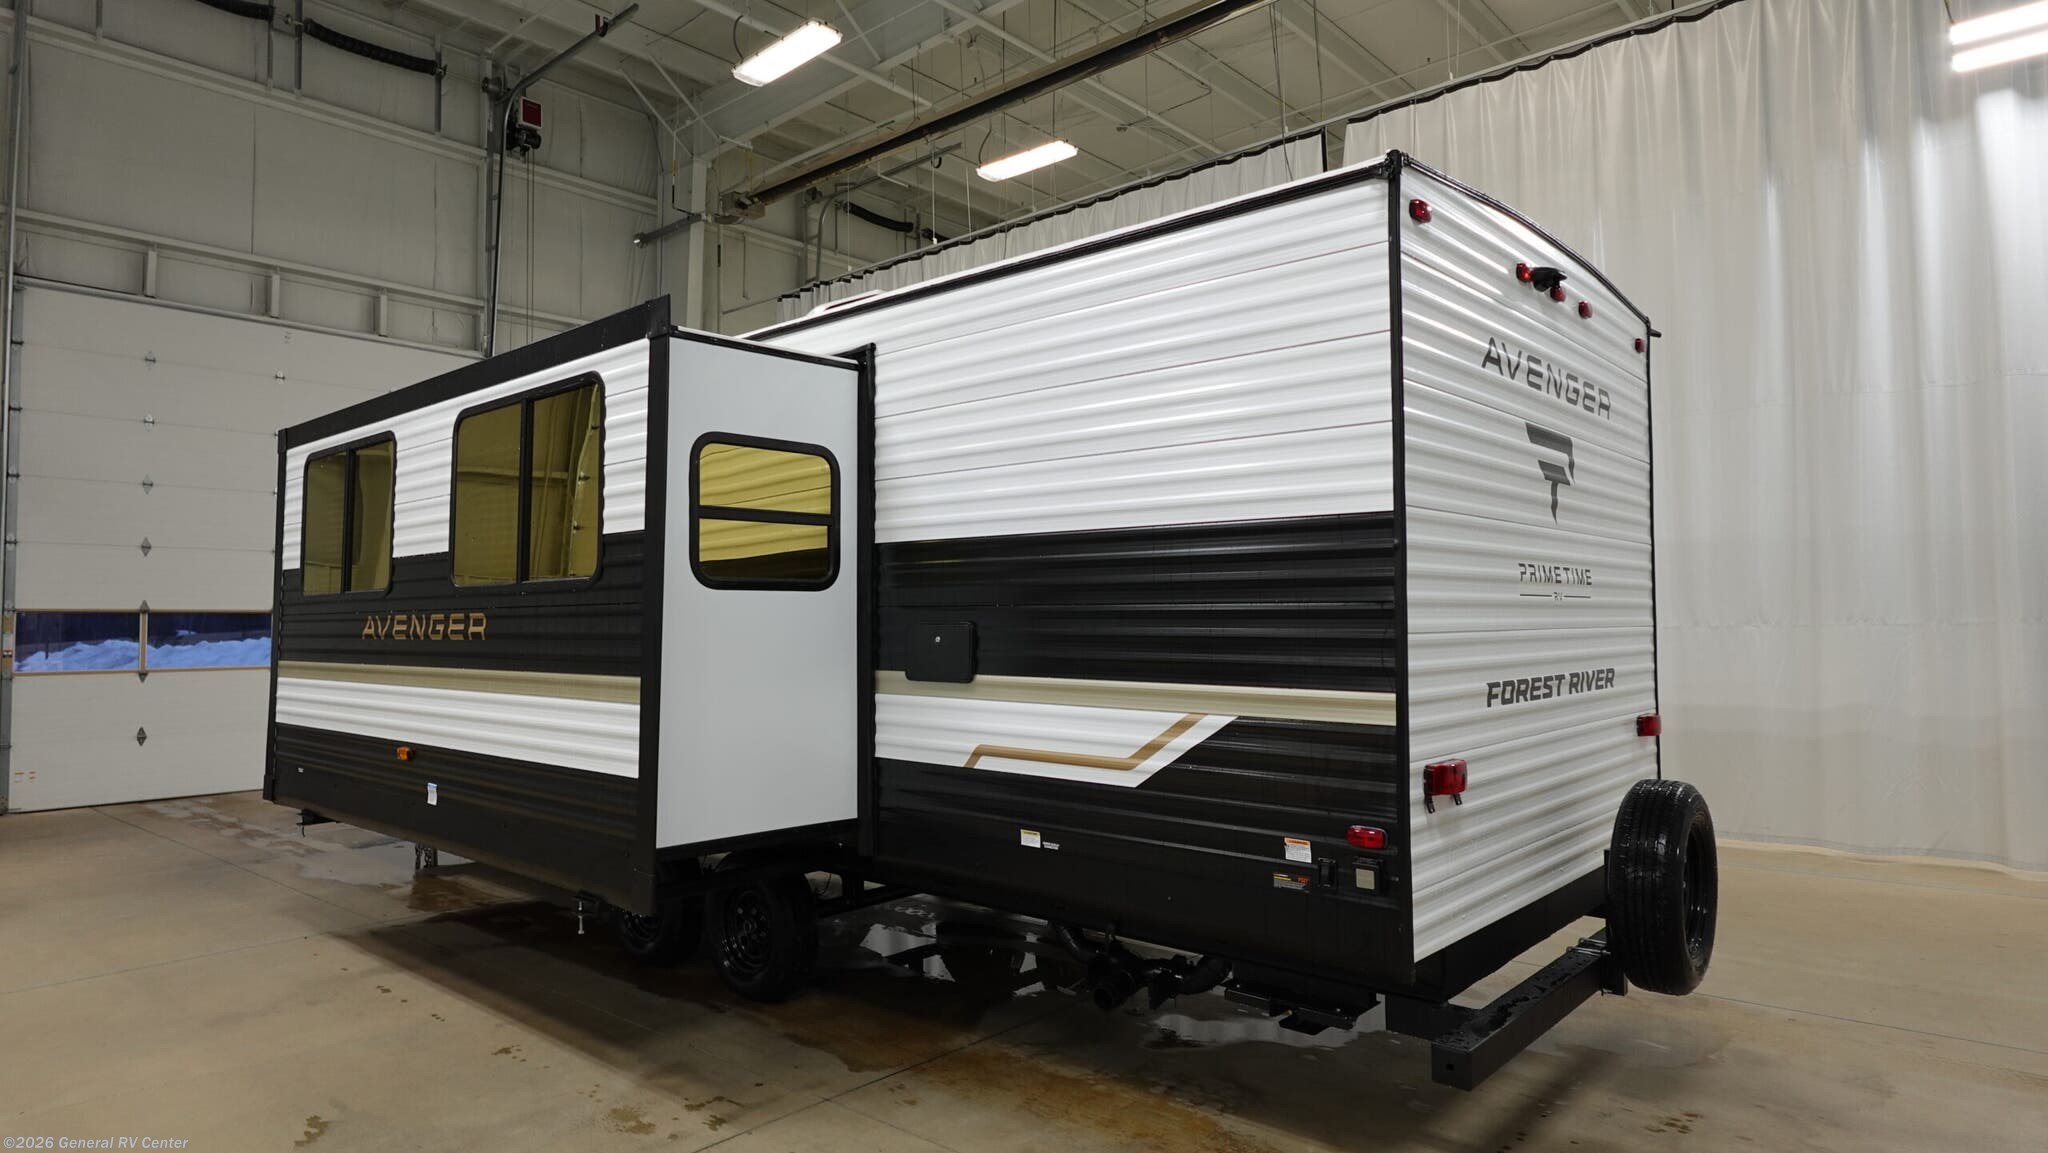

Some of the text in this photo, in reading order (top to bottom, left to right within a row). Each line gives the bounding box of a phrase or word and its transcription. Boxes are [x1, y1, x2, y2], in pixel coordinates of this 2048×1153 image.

[1481, 337, 1611, 420] AVENGER
[1518, 562, 1592, 586] PRIMETIME
[362, 612, 486, 641] AVENGER
[1486, 667, 1615, 708] FOREST RIVER
